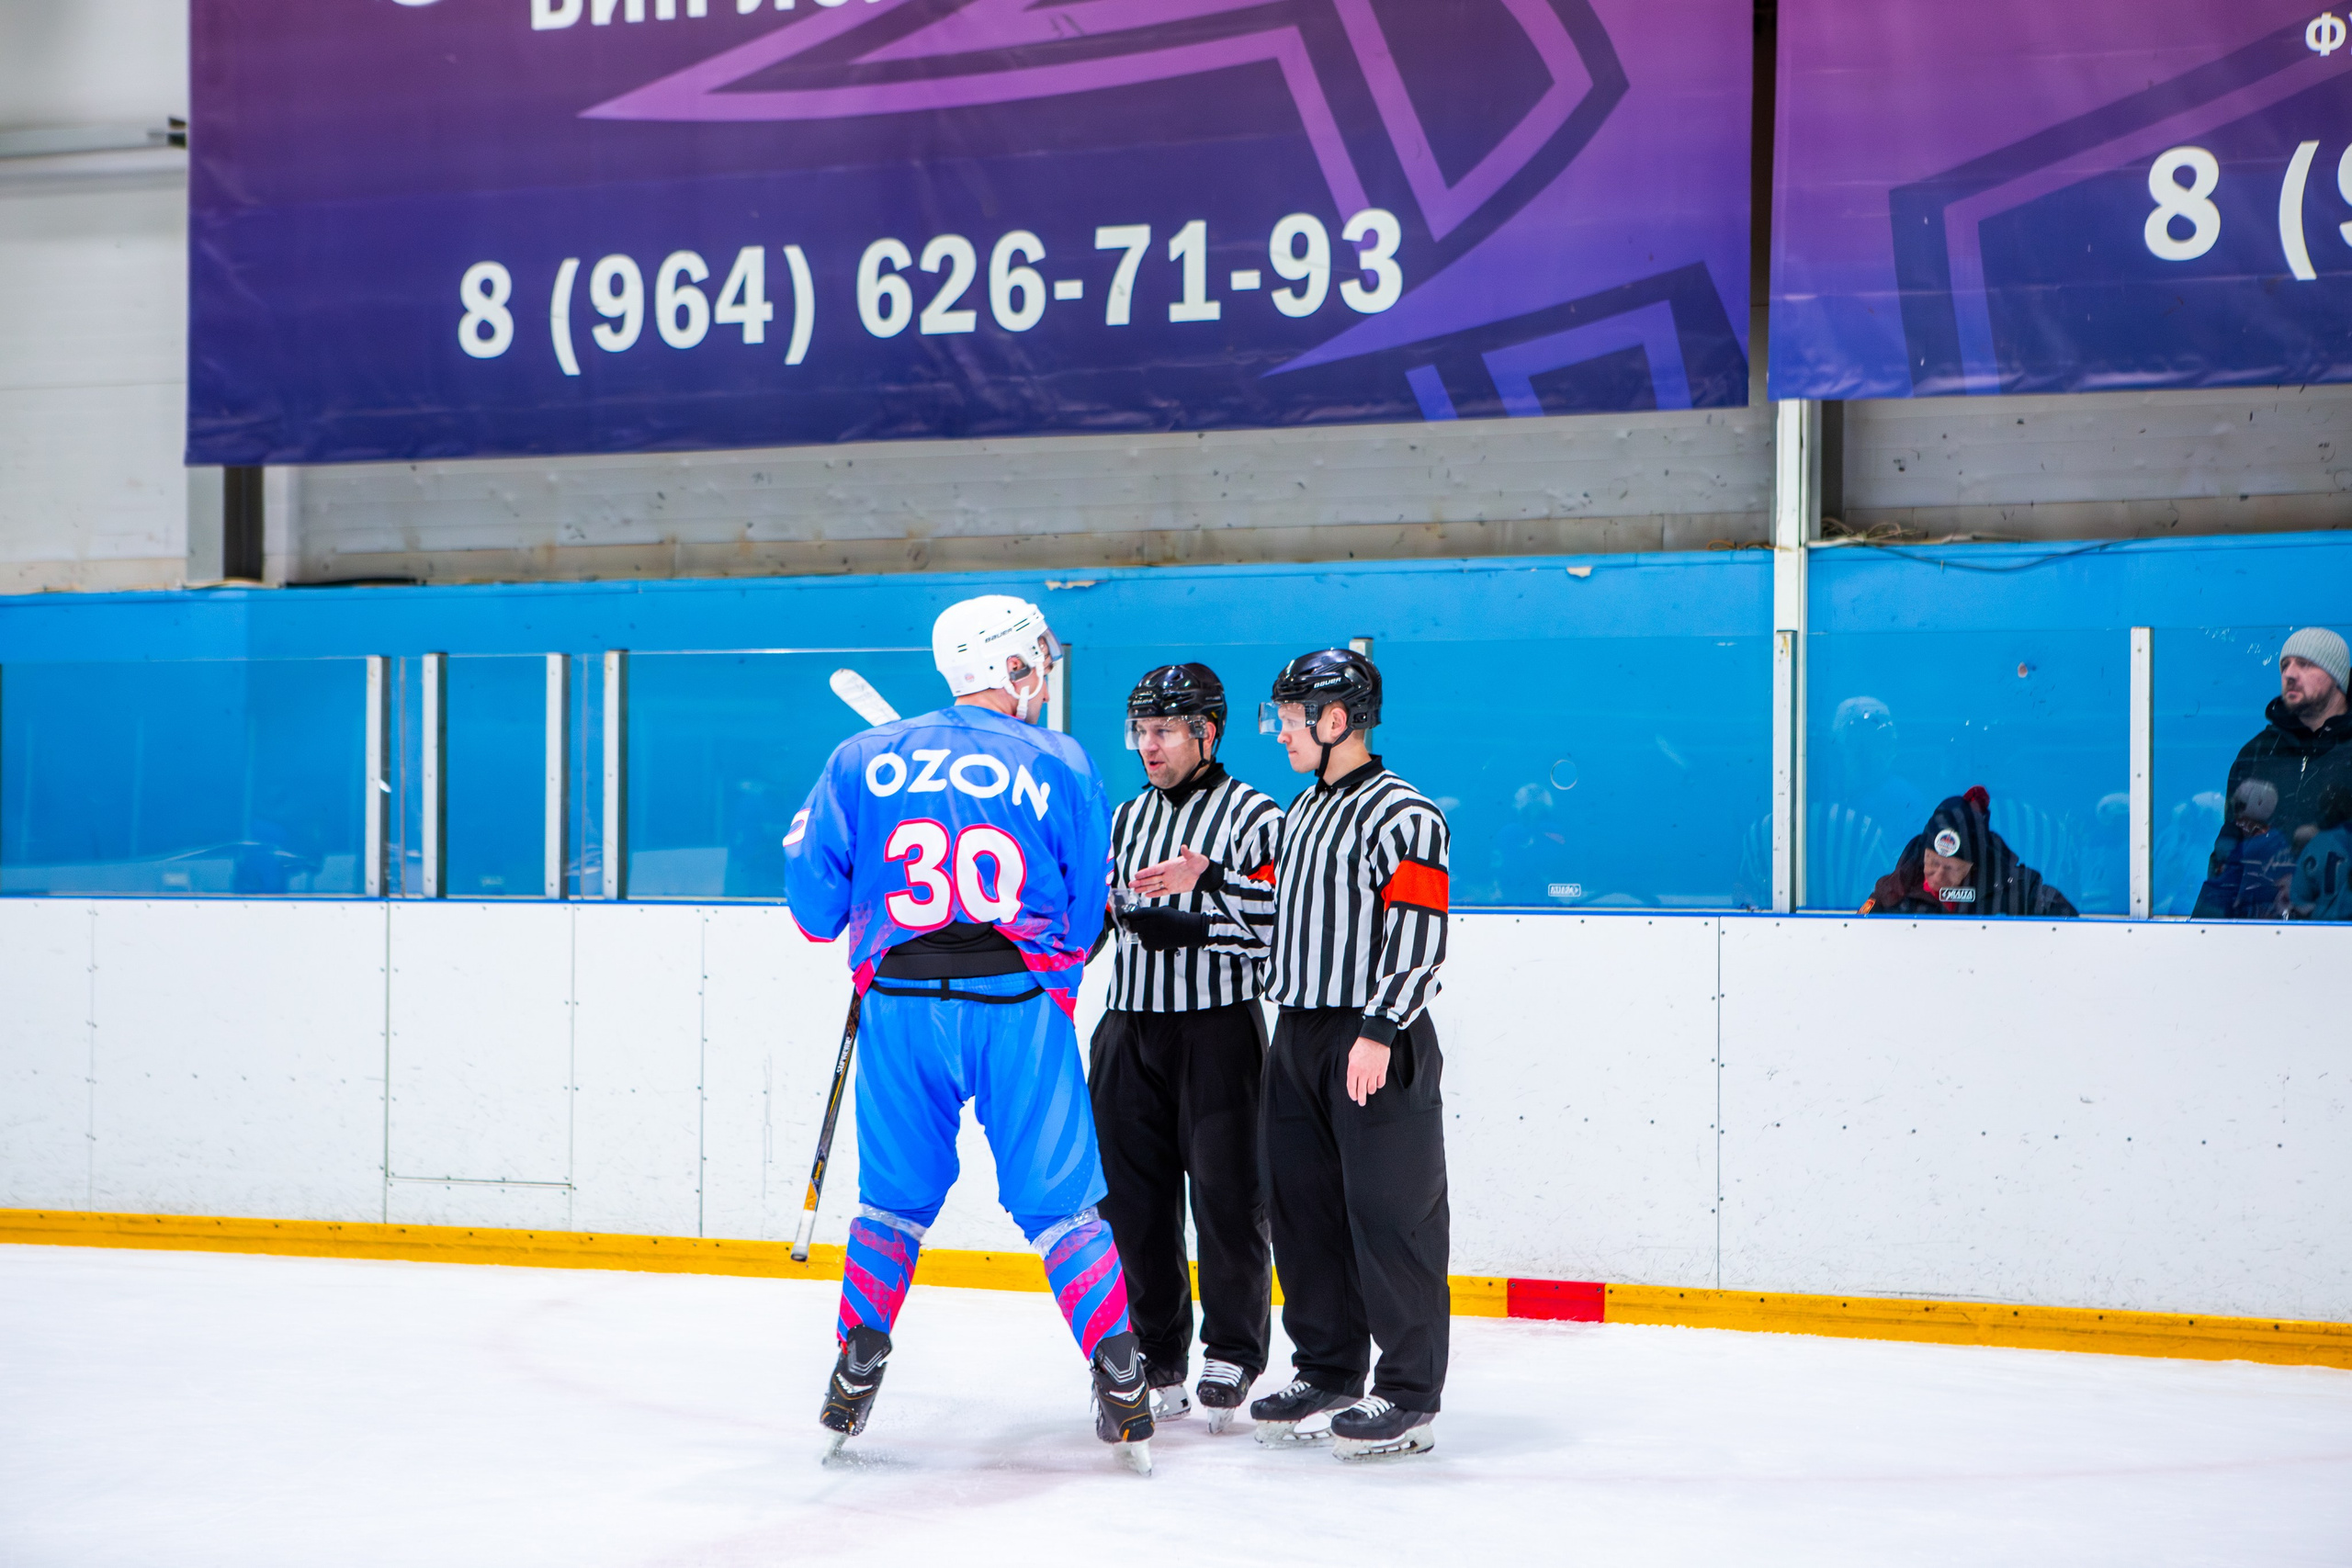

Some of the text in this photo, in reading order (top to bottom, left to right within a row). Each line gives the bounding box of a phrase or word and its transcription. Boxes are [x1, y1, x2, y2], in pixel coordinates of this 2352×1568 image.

[2305, 12, 2352, 56] Ф
[2144, 145, 2222, 262] 8
[458, 208, 1404, 376] 8 (964) 626-71-93
[1314, 677, 1341, 689] BAUER
[865, 749, 1051, 821] OZON
[884, 818, 1027, 931] 30
